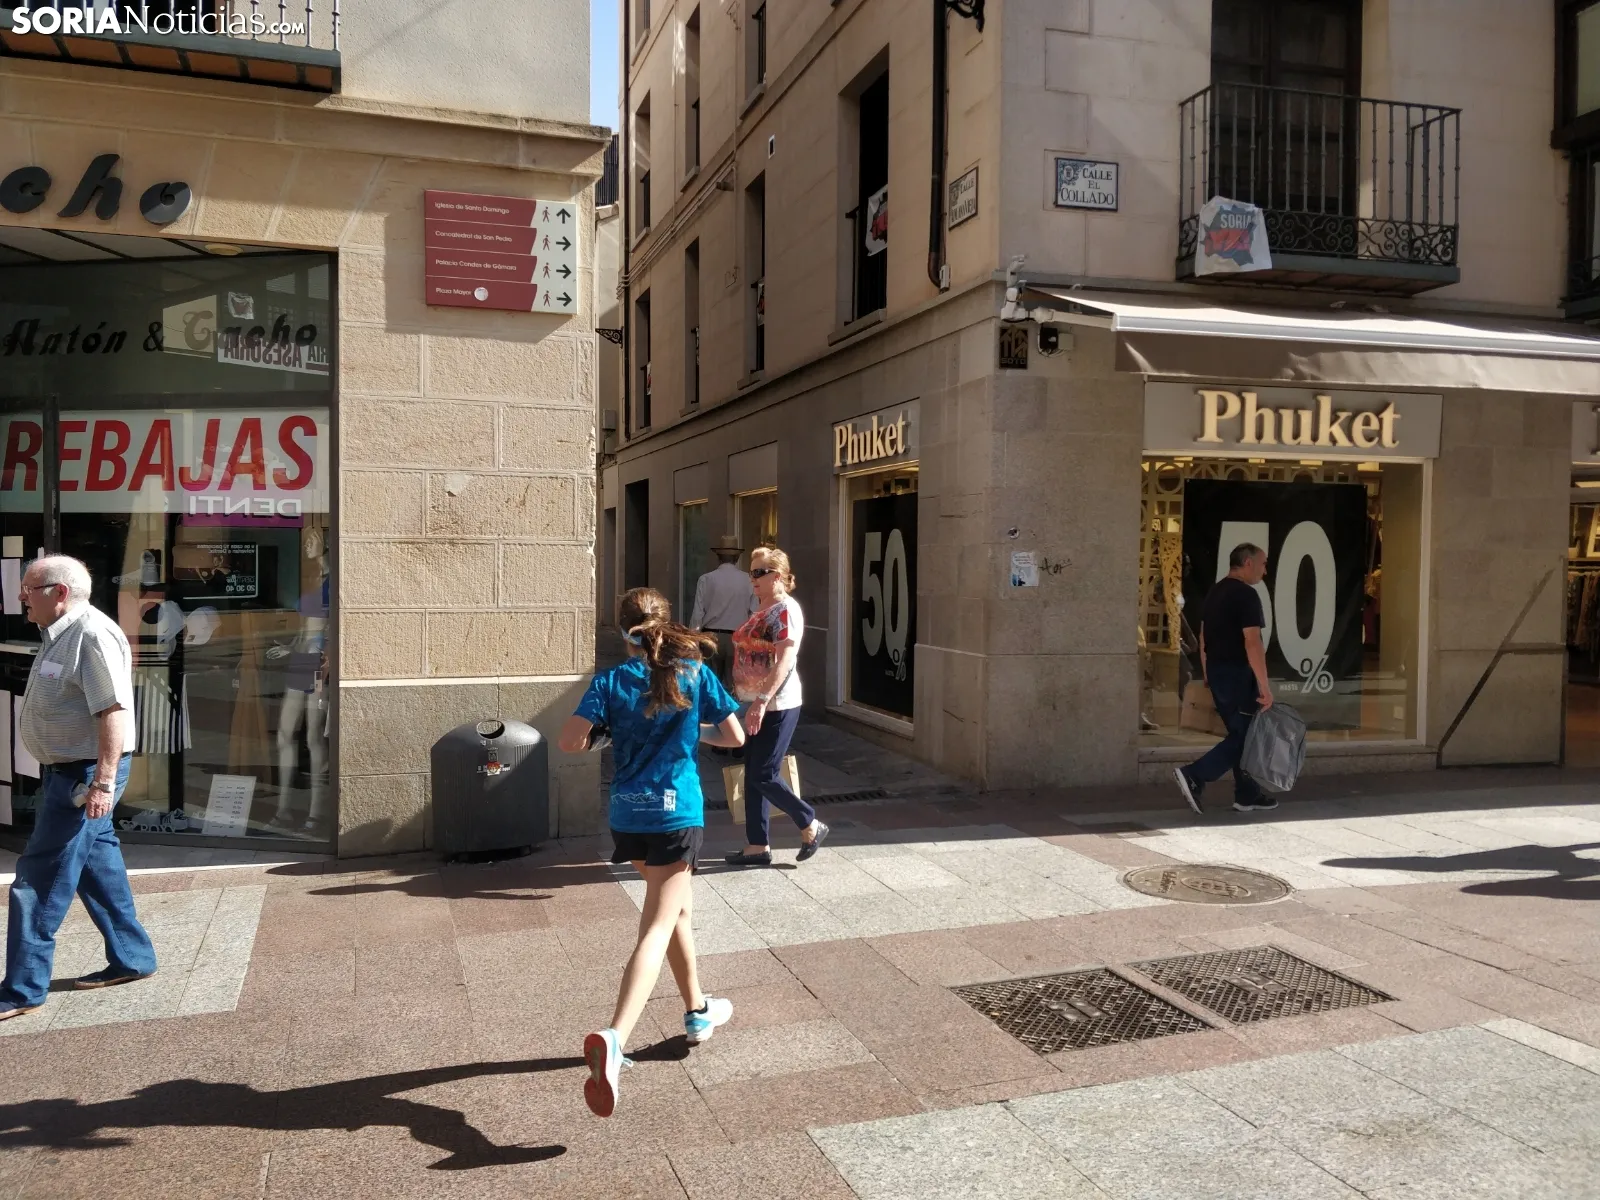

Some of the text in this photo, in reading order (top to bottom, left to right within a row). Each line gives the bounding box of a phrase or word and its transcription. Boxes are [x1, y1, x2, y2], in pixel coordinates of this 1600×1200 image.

[1082, 168, 1113, 180] CALLE
[1088, 180, 1101, 189] EL
[1060, 187, 1115, 205] COLLADO
[464, 204, 482, 212] Santo
[482, 205, 510, 214] Domingo
[435, 230, 473, 239] Concatedral
[435, 258, 458, 266] Palacio
[458, 260, 482, 268] Condes
[492, 262, 517, 271] Gómara
[453, 288, 472, 296] Mayor
[143, 321, 164, 351] &
[1196, 389, 1402, 449] Phuket
[833, 409, 907, 467] Phuket
[0, 415, 318, 492] REBAJAS
